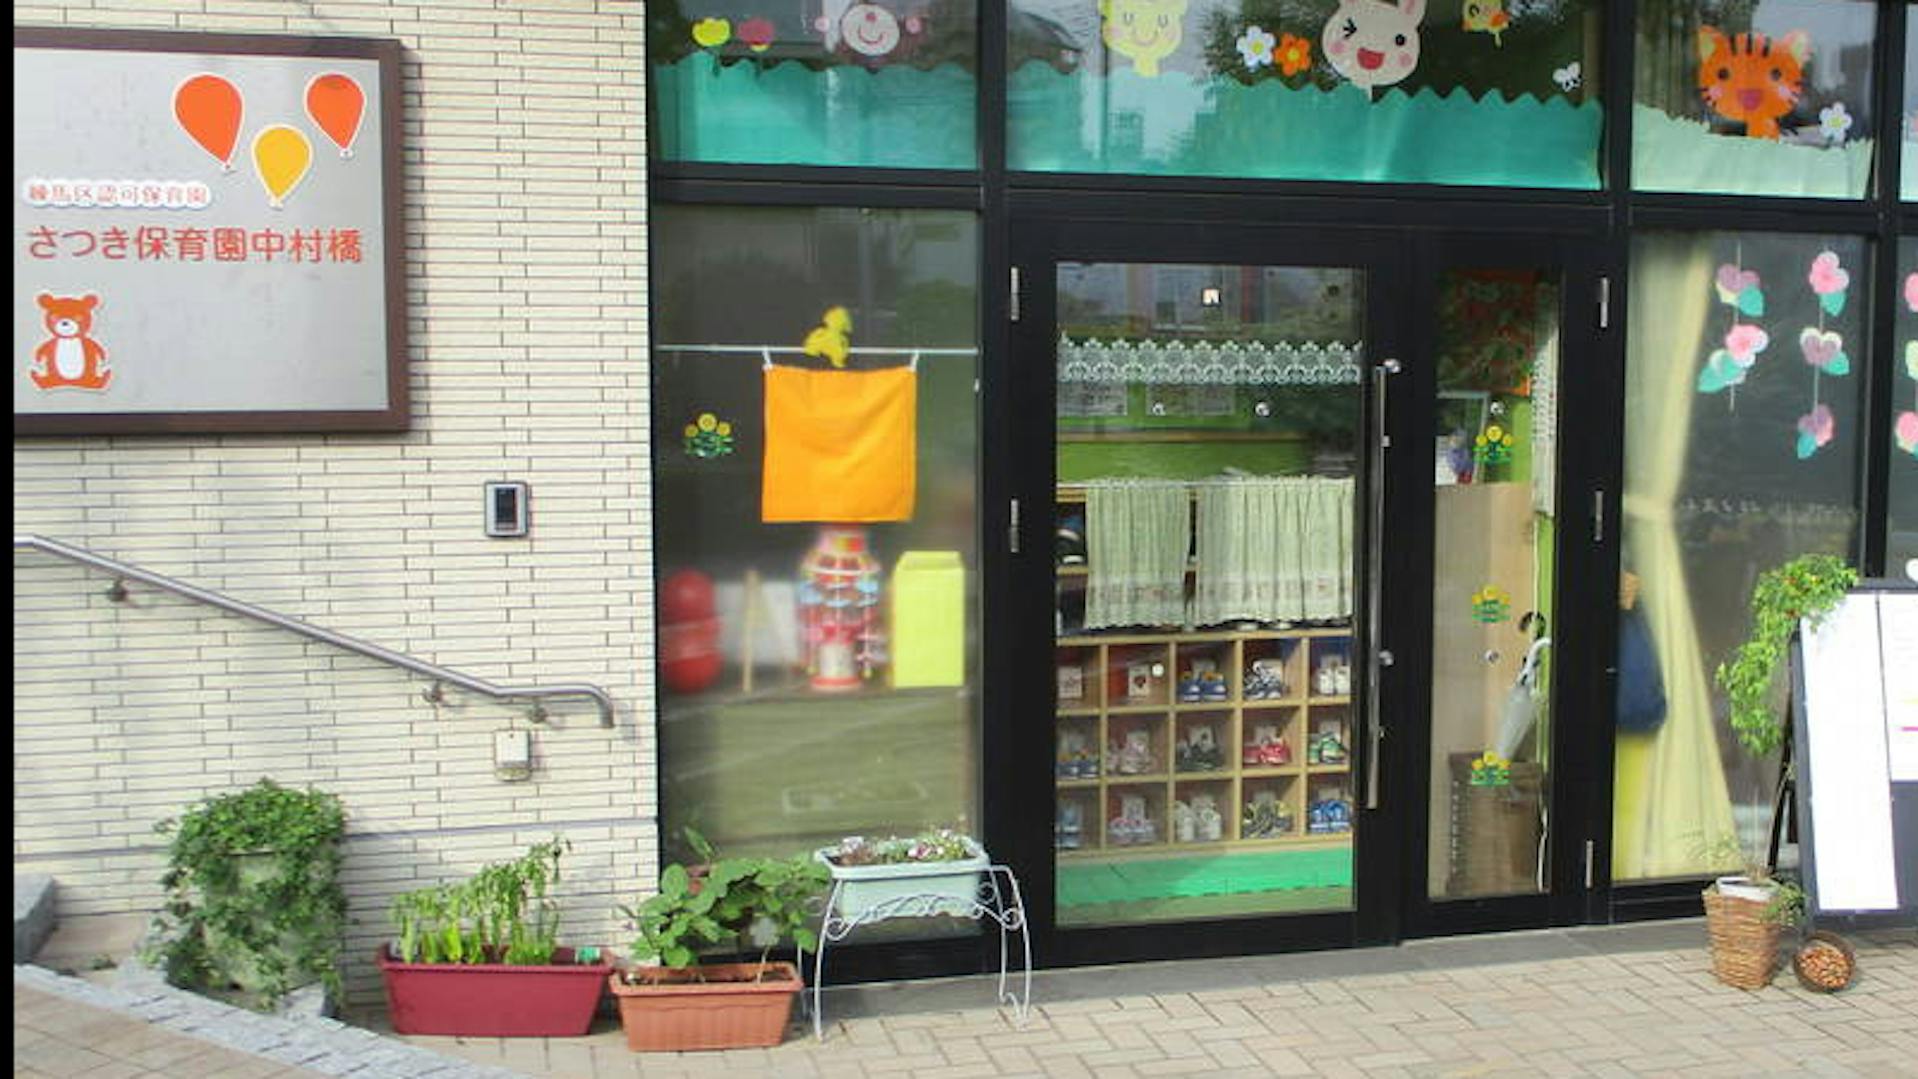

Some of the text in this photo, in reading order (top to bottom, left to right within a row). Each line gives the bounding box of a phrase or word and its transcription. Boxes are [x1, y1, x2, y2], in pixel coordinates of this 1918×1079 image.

[27, 225, 364, 263] さつき保育園中村橋
